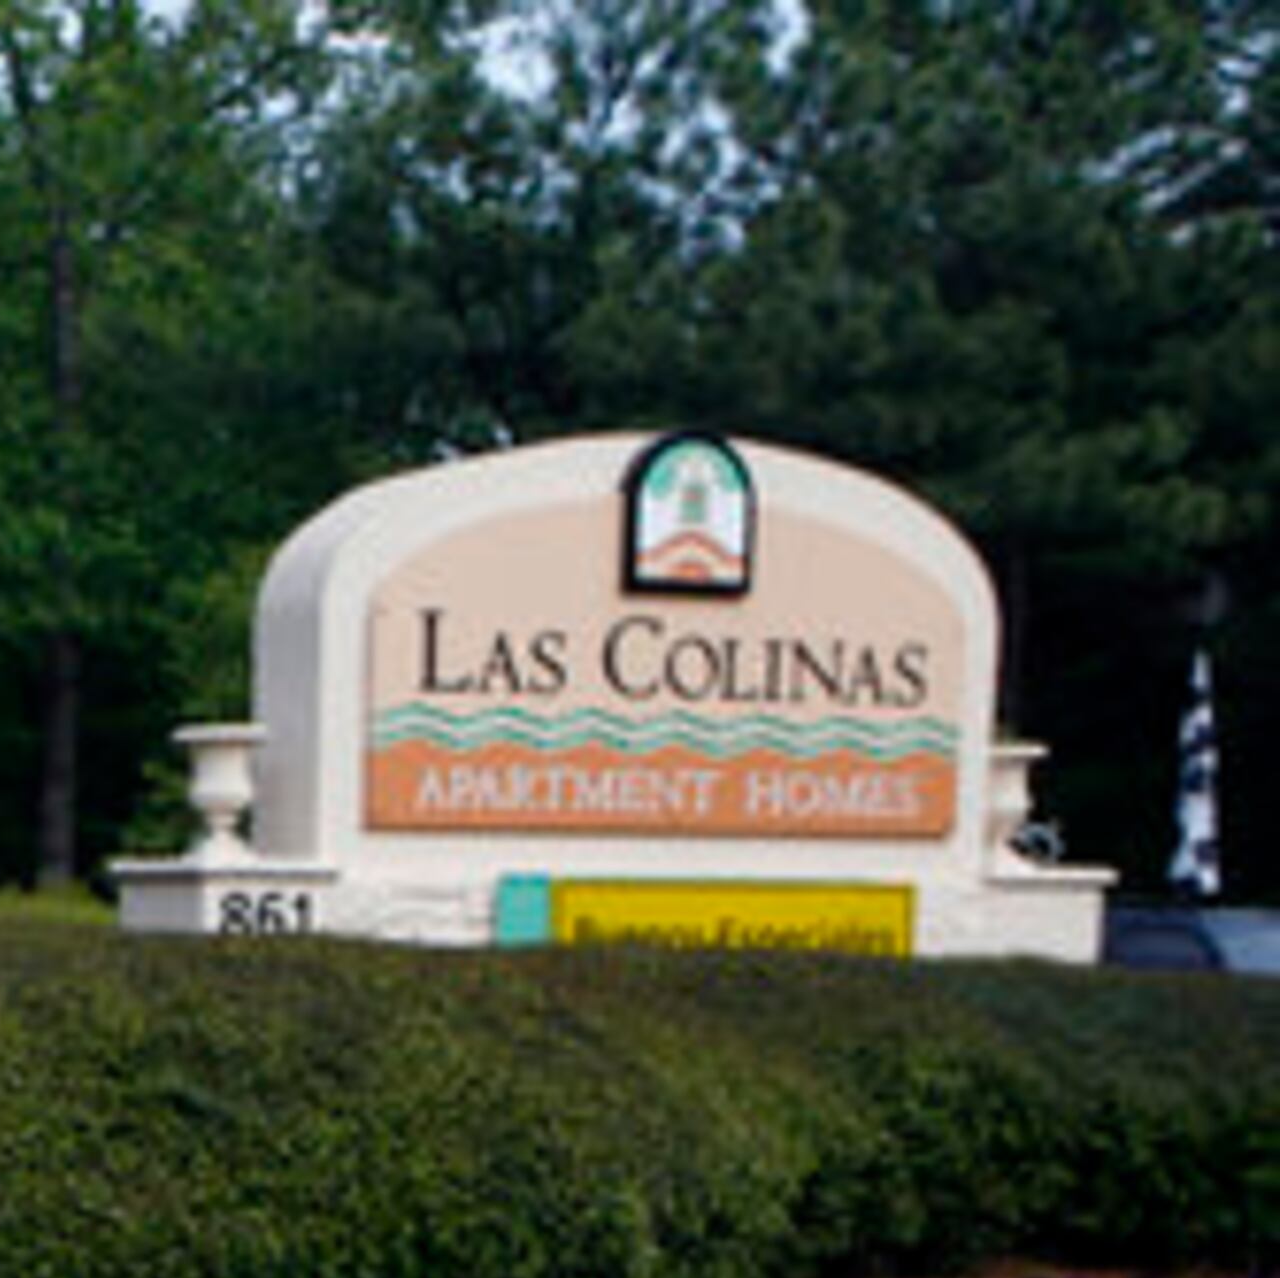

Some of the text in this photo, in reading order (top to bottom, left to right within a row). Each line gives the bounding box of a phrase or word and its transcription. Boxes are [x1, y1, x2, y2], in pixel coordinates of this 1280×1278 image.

[420, 608, 929, 708] LAS COLINAS
[417, 761, 922, 818] APARTMENT HOMES
[220, 891, 311, 936] 861
